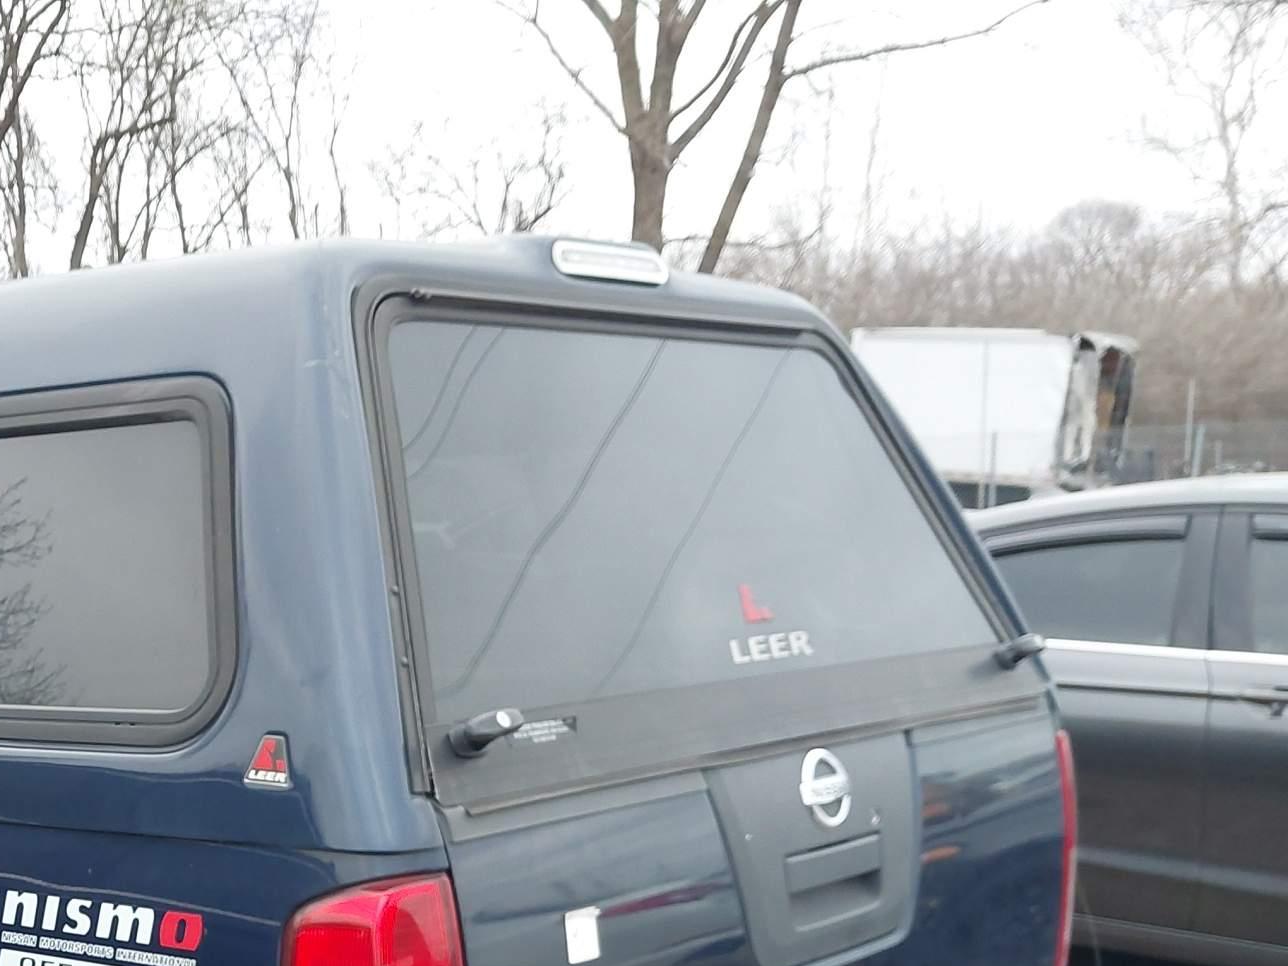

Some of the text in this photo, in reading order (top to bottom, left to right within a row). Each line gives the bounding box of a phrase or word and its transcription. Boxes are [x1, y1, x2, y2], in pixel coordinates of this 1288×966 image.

[728, 630, 814, 664] LEER
[0, 930, 37, 947] NISSAN
[38, 935, 114, 959] MOTORSPORTS
